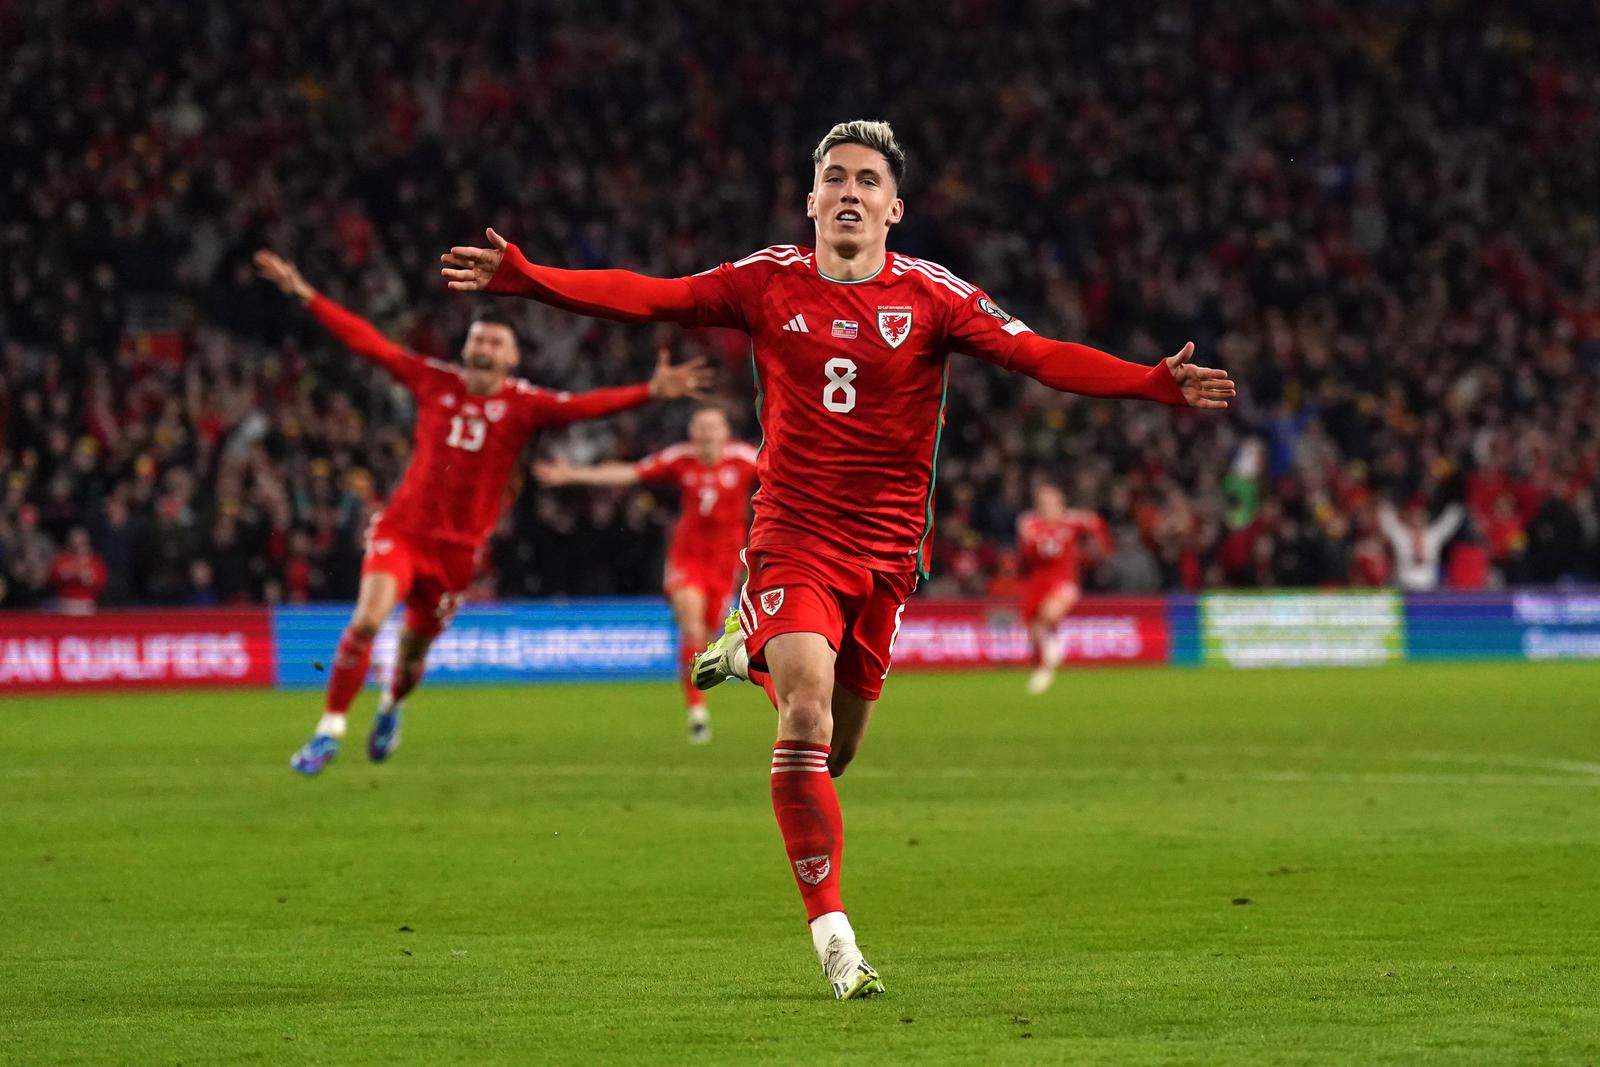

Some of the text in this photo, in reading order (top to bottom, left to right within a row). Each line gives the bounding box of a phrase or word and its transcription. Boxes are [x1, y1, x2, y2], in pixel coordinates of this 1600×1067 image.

[822, 357, 857, 413] 8
[446, 415, 486, 452] 13
[698, 486, 718, 517] 7
[58, 632, 249, 682] QUALIFIERS
